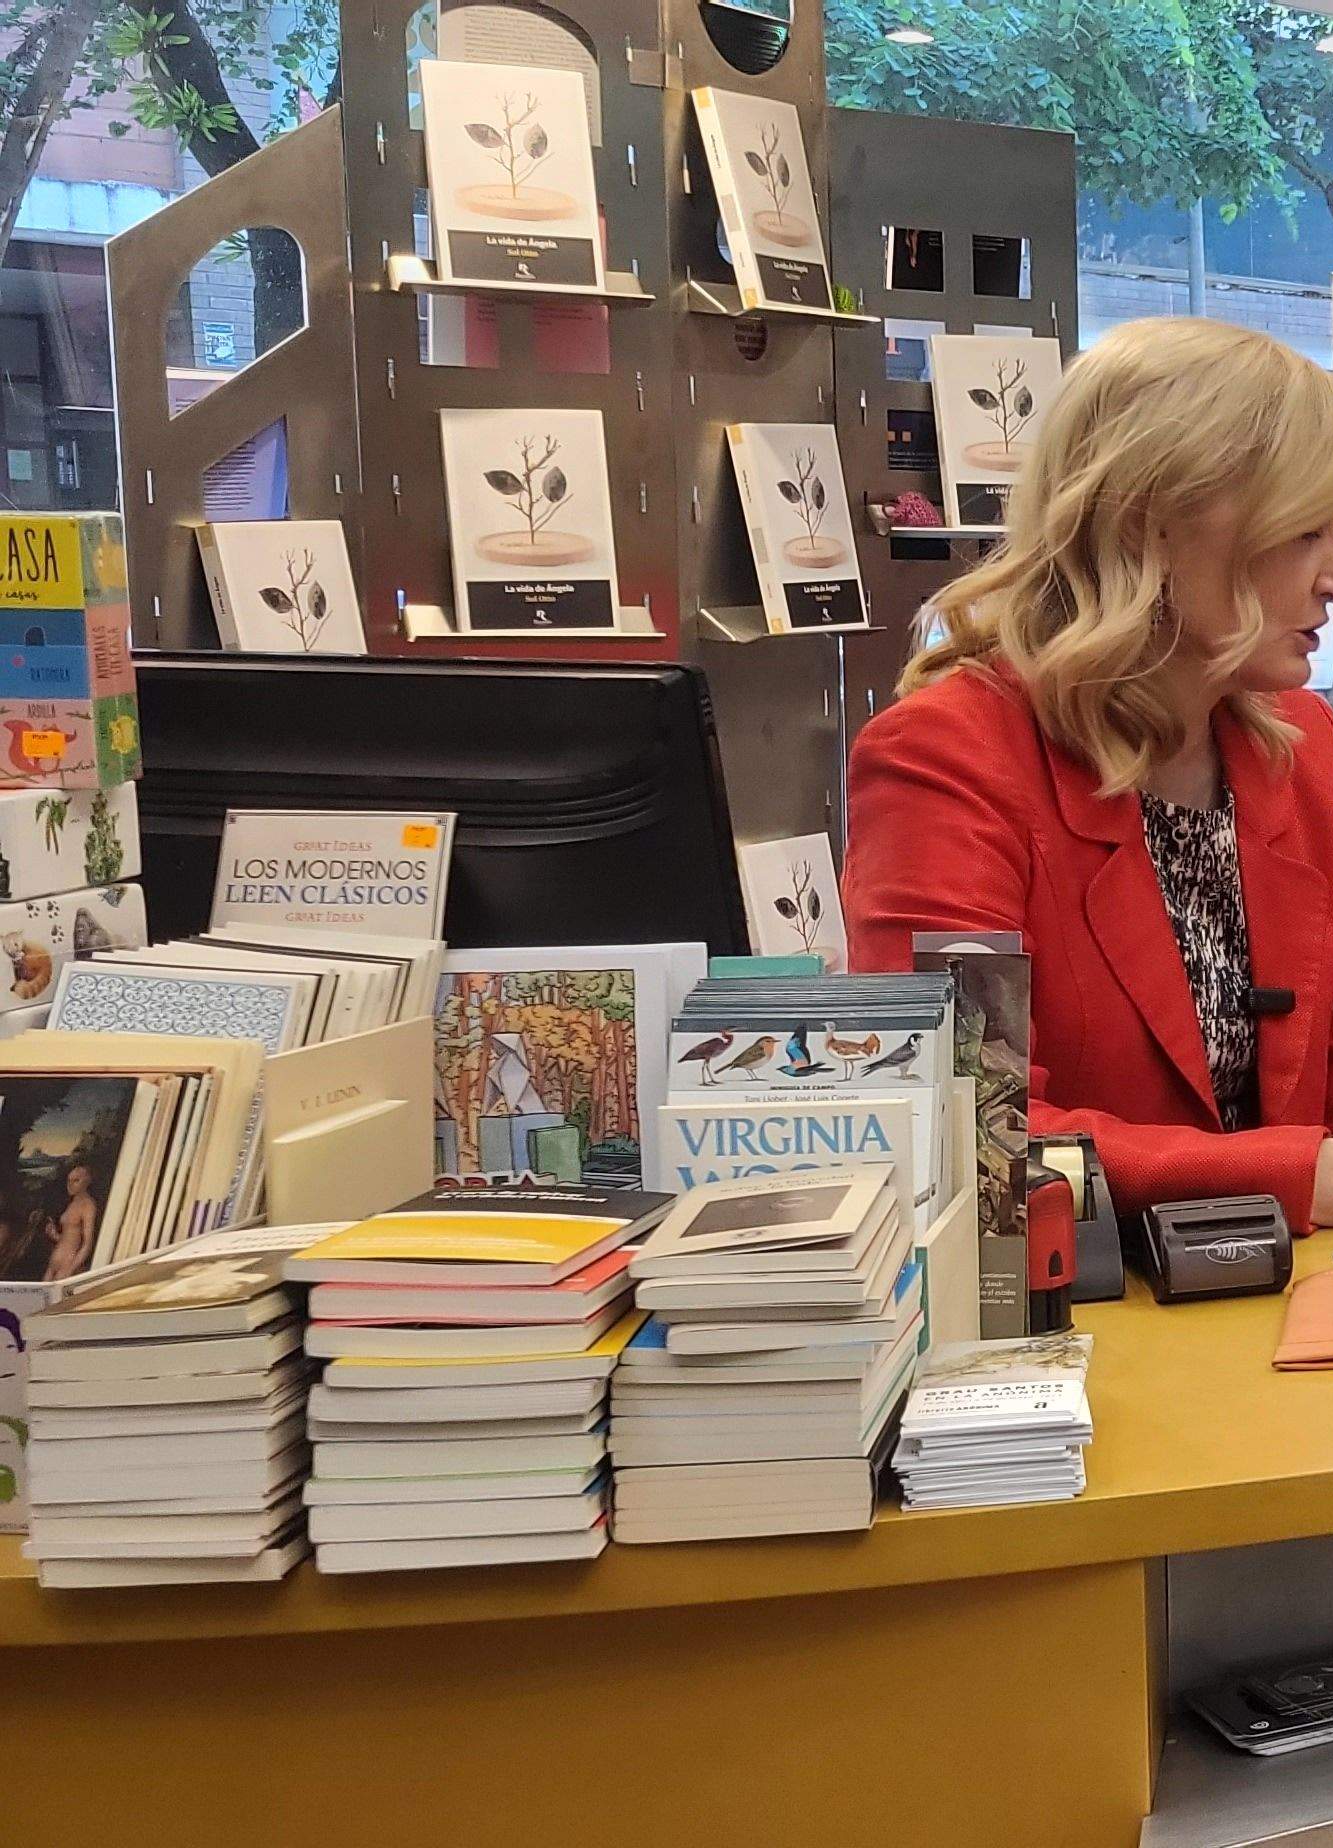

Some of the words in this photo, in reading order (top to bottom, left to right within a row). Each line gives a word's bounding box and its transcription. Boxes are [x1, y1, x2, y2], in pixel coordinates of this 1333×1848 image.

[486, 236, 497, 245] La
[498, 237, 516, 246] vida
[517, 238, 527, 246] de
[528, 237, 559, 249] Ángela
[504, 585, 515, 593] La
[516, 584, 534, 593] vida
[534, 584, 546, 592] de
[546, 582, 575, 594] Ángela
[27, 703, 57, 719] ARDILLA
[293, 841, 331, 852] GREAT
[333, 840, 373, 852] IDEAS
[233, 859, 278, 880] LOS
[285, 860, 427, 881] MODERNOS
[225, 884, 296, 904] LEEN
[301, 881, 428, 906] CLÁSICOS
[284, 912, 321, 923] GREAT
[326, 911, 365, 923] IDEAS
[327, 1085, 361, 1105] LENIN
[812, 1093, 828, 1102] Luis
[675, 1113, 893, 1157] VIRGINIA
[925, 1388, 978, 1396] GRAU
[989, 1383, 1064, 1391] SANTOS
[982, 1388, 1063, 1397] ANÓNIMA
[1033, 1401, 1048, 1409] a
